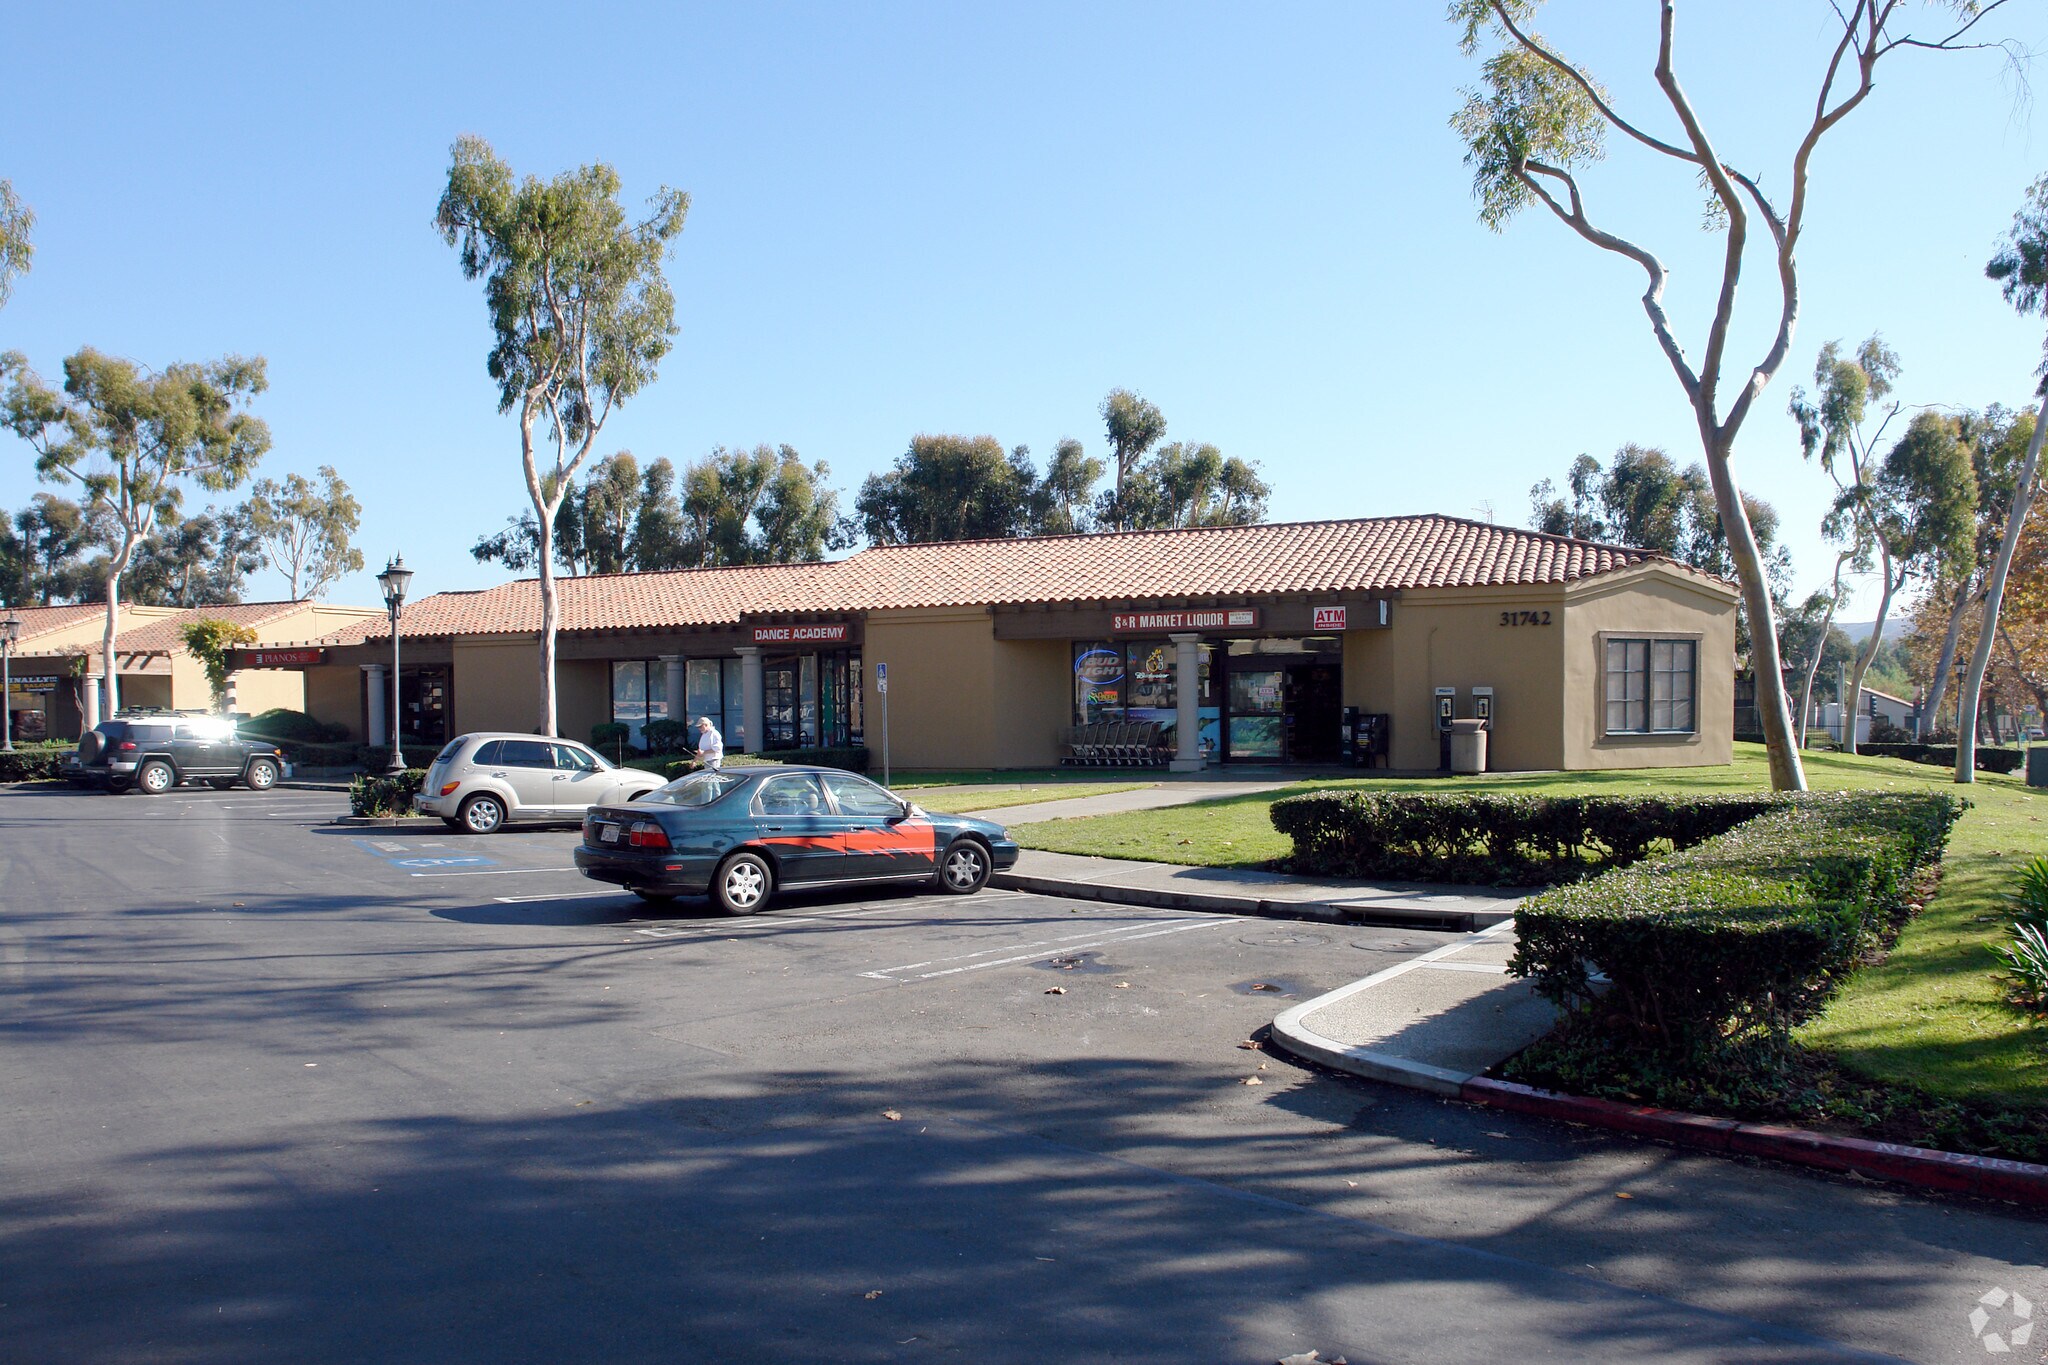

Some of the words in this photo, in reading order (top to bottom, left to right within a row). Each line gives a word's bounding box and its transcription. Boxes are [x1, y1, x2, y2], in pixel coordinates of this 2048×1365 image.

[1139, 614, 1183, 628] MARKET
[1186, 612, 1224, 627] LIQUOR
[1316, 609, 1344, 622] ATM
[1499, 611, 1552, 626] 31742
[755, 628, 790, 640] DANCE
[793, 626, 844, 639] ACADEMY
[265, 653, 297, 662] PIANOS
[1085, 657, 1120, 665] BUD
[1077, 666, 1124, 676] LIGHT
